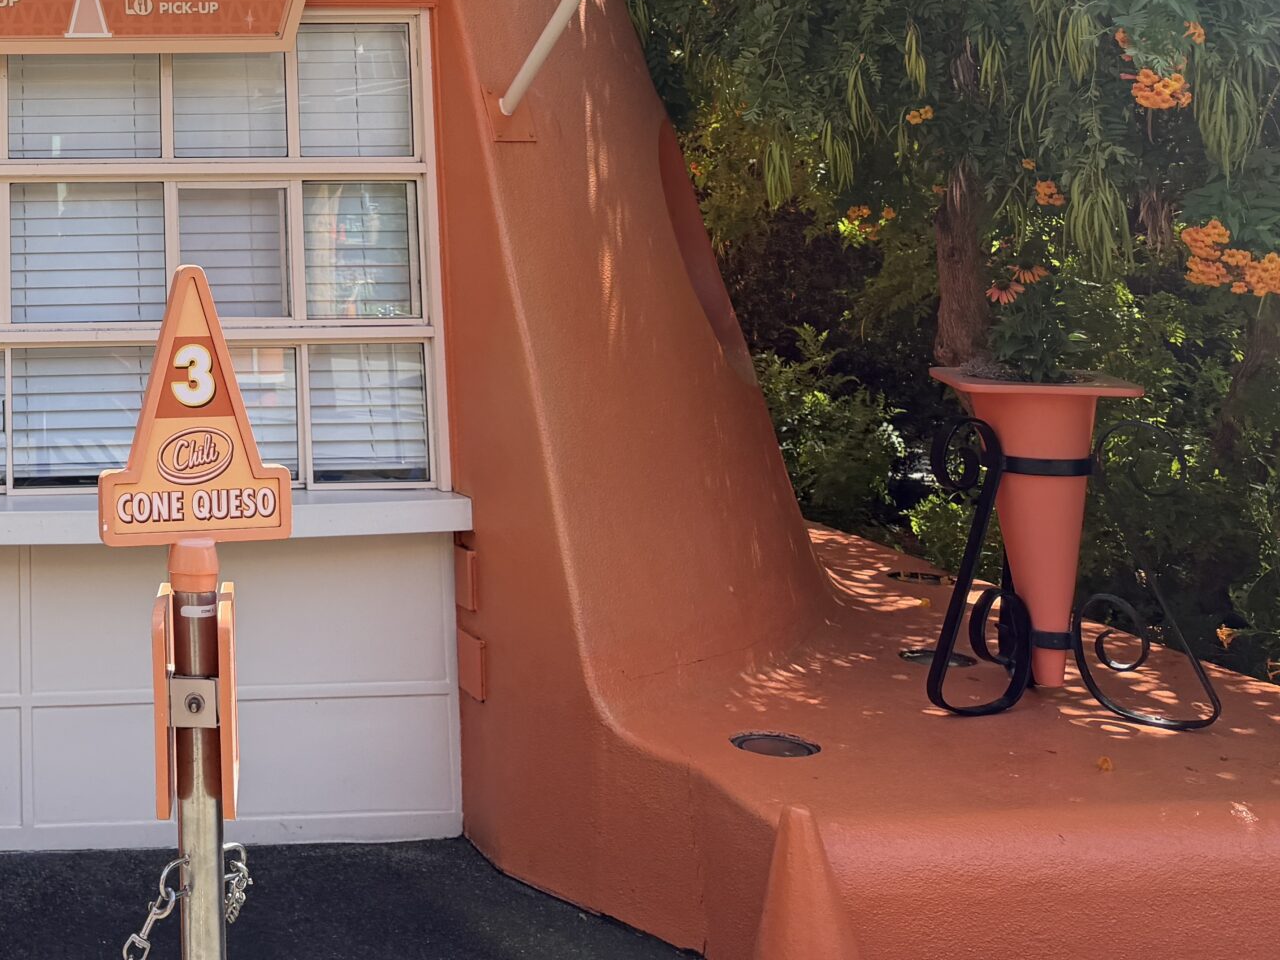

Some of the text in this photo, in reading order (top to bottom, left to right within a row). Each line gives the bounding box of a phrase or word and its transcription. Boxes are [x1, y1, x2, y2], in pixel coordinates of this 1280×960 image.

[159, 1, 219, 14] PICK-UP
[171, 343, 216, 407] 3
[172, 434, 219, 471] Chili
[117, 487, 276, 523] CONE QUESO
